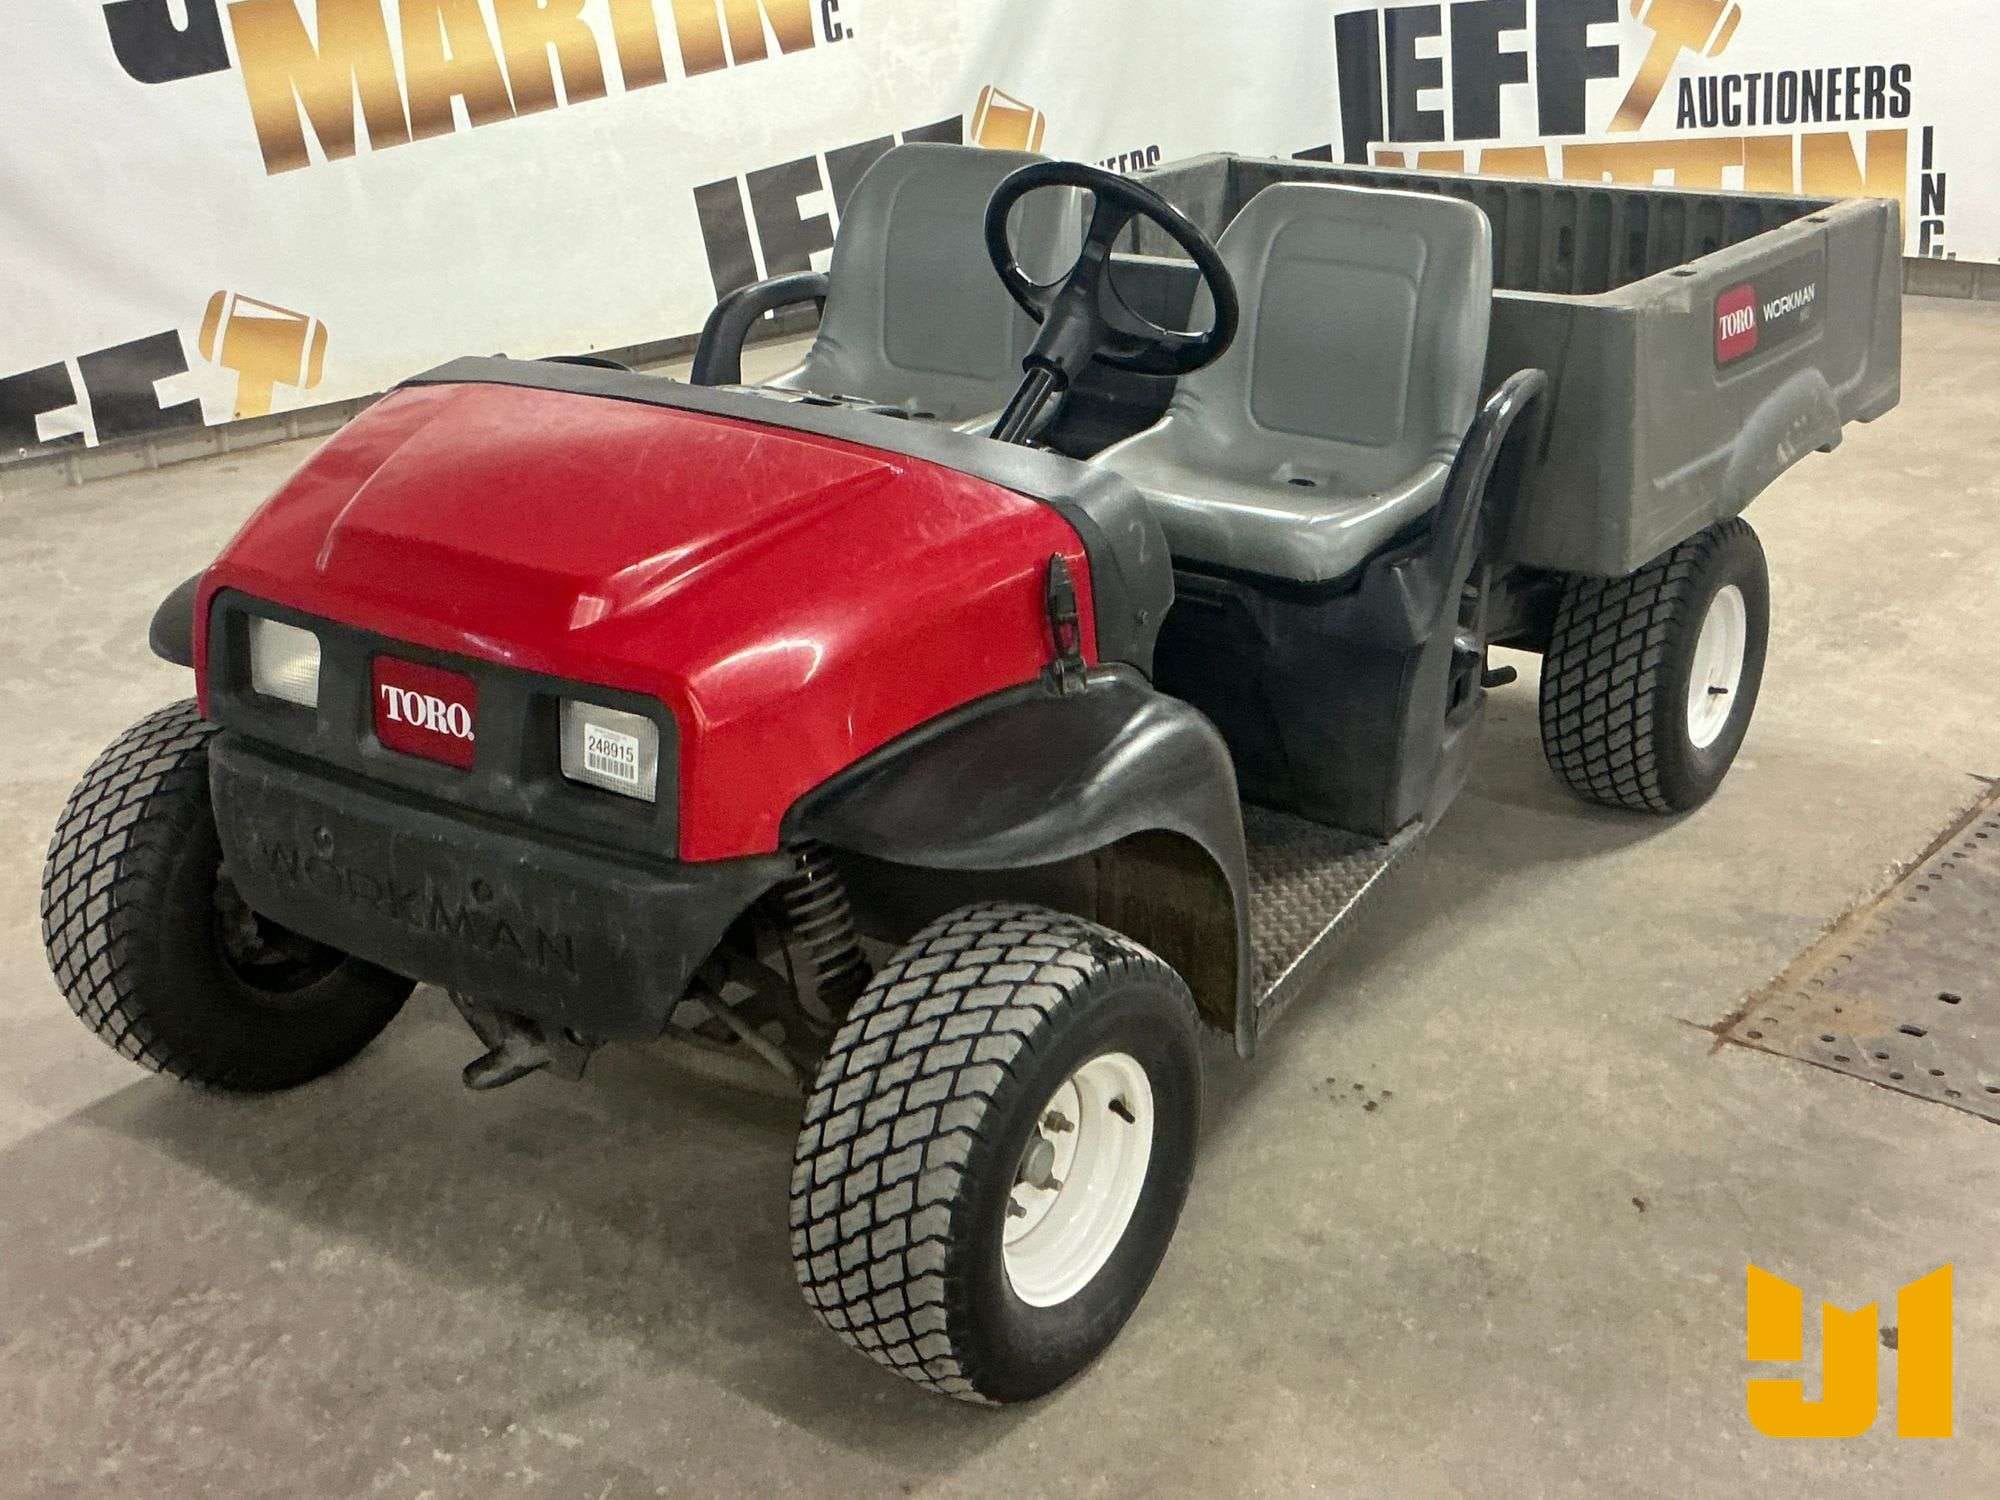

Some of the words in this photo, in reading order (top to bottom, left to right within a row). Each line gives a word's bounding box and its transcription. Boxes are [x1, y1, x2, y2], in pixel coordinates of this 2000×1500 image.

[1676, 63, 1912, 129] AUCTIONEERS
[1719, 305, 1754, 341] TORO
[1762, 282, 1816, 322] WORKMAN
[381, 683, 473, 740] TORO
[588, 735, 635, 763] 248915
